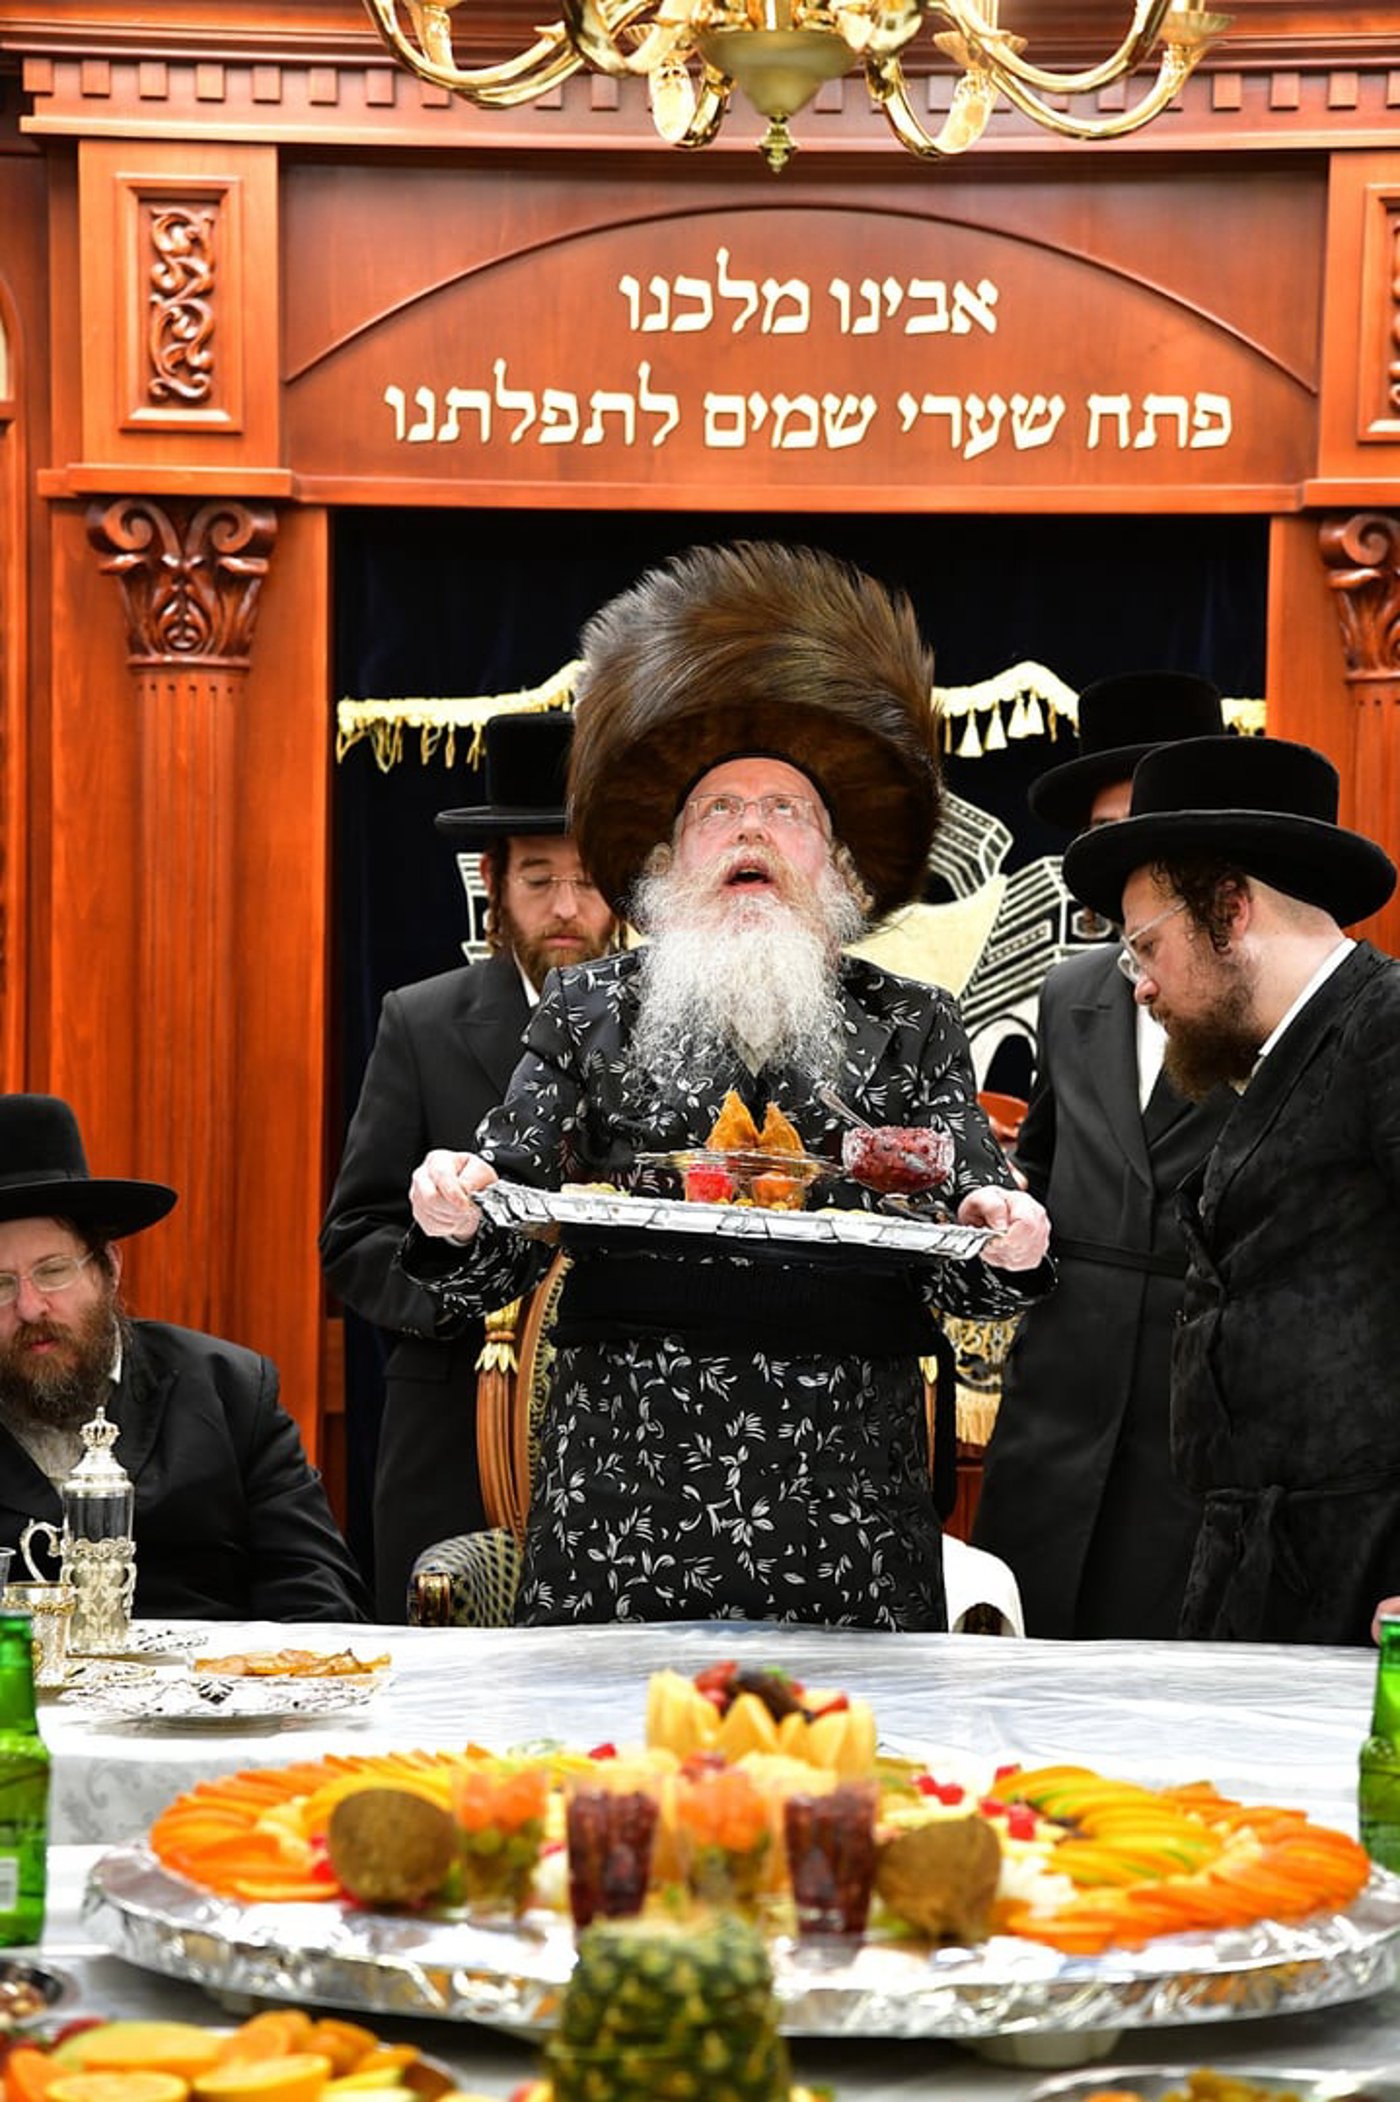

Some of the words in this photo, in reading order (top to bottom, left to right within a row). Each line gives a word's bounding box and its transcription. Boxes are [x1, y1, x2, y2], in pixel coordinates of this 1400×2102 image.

[617, 245, 812, 335] מלכנו
[827, 274, 1001, 336] אבינו
[382, 356, 681, 448] לתפלתנו
[702, 389, 879, 450] שמים
[896, 390, 1067, 461] שערי
[1085, 390, 1234, 450] פתח
